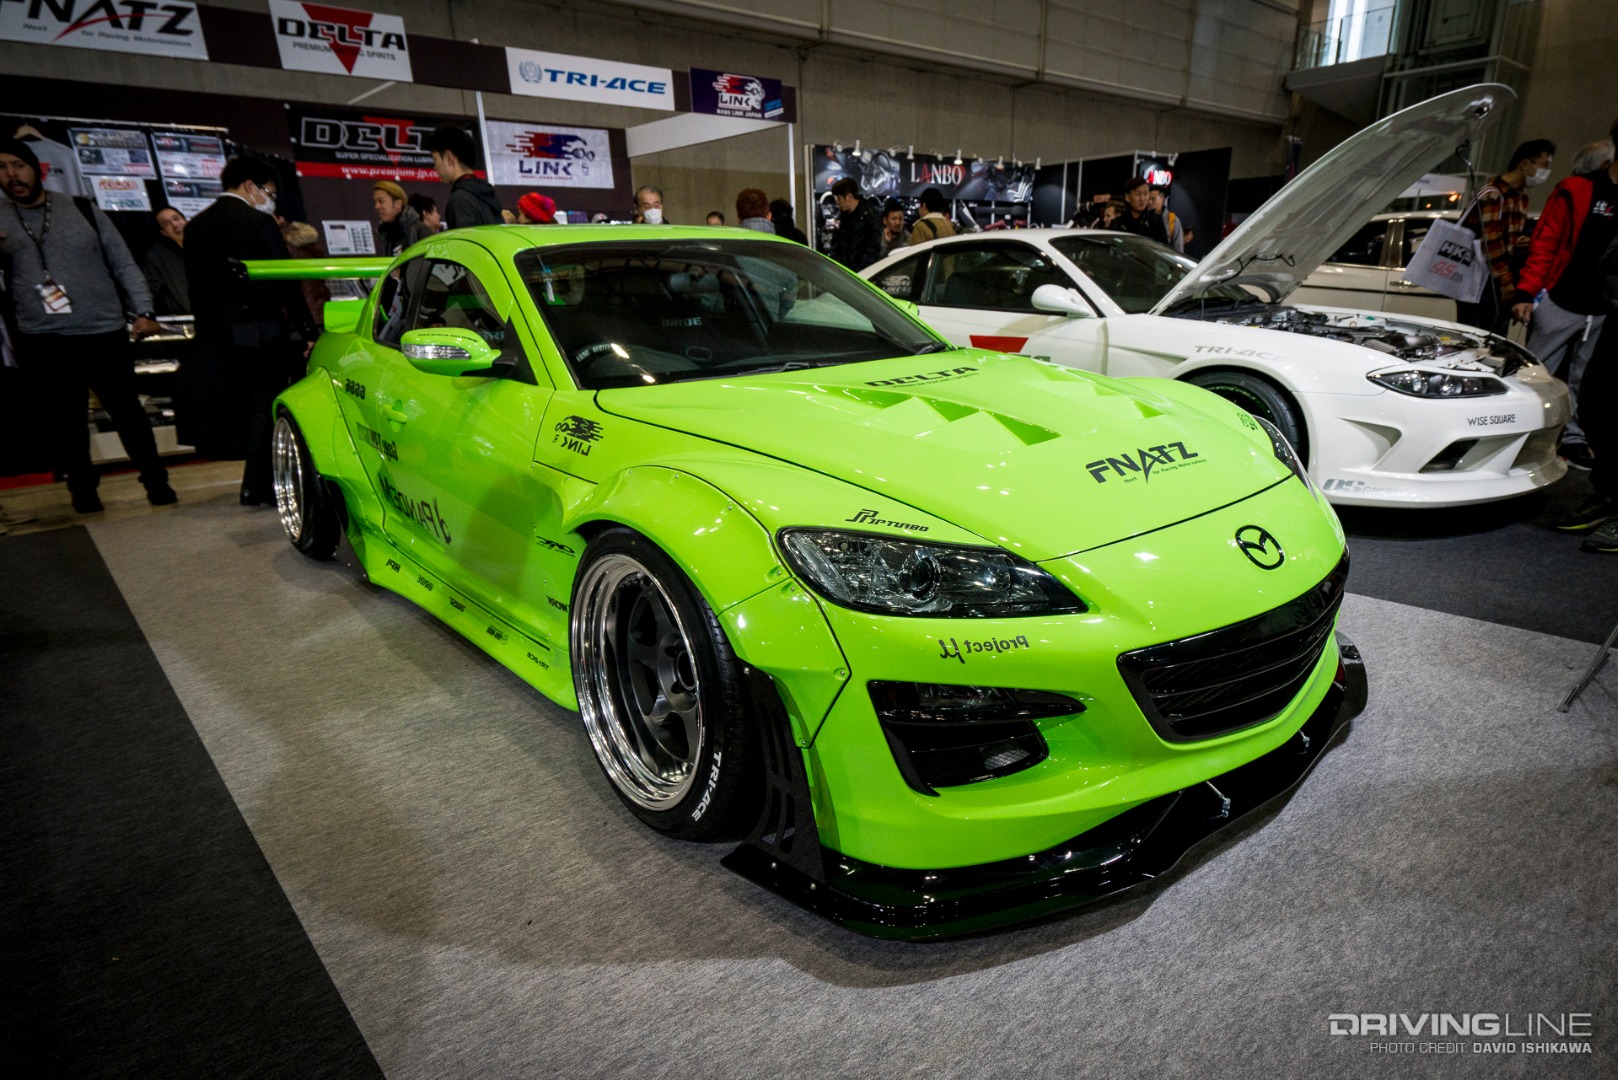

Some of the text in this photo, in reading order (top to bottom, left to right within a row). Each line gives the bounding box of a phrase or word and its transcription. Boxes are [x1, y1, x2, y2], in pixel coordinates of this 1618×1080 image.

[0, 0, 196, 36] NATZ
[98, 31, 130, 42] Racing
[278, 17, 406, 51] DELTA
[293, 41, 332, 53] PREMIUM
[366, 50, 396, 61] SPIRITS
[544, 68, 667, 95] TRI-ACE
[720, 95, 750, 107] LINK
[301, 116, 437, 154] DELT
[335, 151, 359, 161] SUPER
[360, 153, 412, 163] SPECIALIZATION
[519, 160, 573, 175] LINK
[341, 166, 440, 179] www.premium-jp.co
[911, 162, 963, 186] LANBO
[1439, 240, 1474, 263] HKS
[864, 367, 979, 387] DELTA
[1467, 414, 1516, 426] WISE SQUARE
[1085, 441, 1198, 484] FNATZ
[691, 751, 722, 822] TRI-ACE
